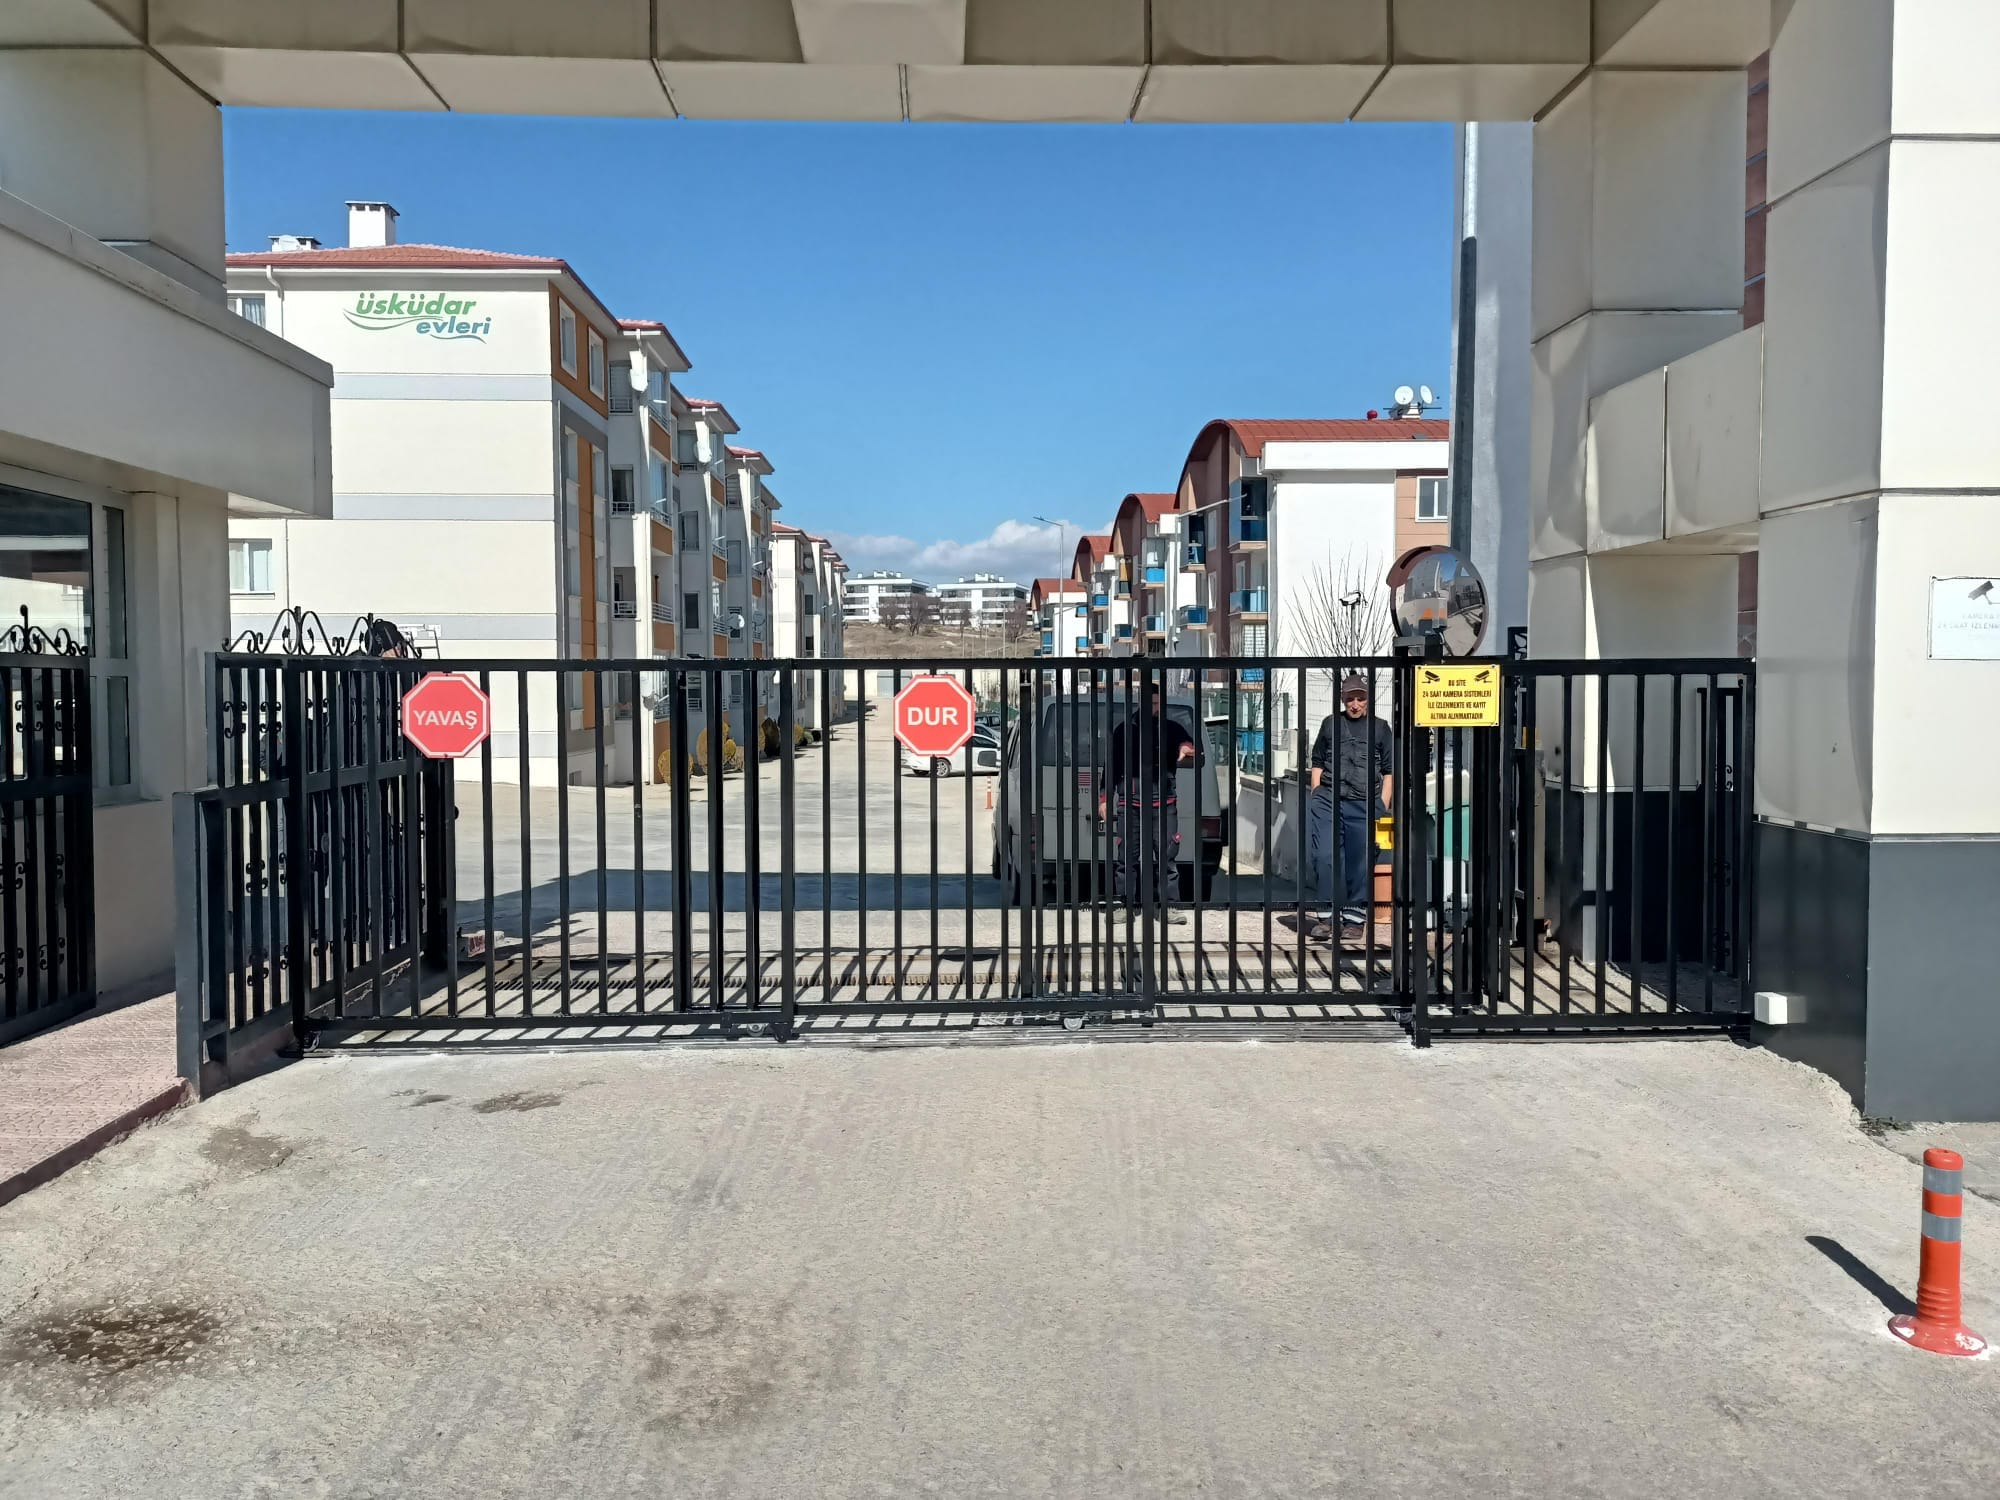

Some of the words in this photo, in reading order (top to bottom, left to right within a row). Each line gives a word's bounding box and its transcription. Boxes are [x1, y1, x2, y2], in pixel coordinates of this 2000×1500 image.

[356, 292, 477, 315] üsküdar
[416, 316, 492, 334] evleri
[413, 710, 478, 730] YAVAŞ
[907, 706, 959, 726] DUR
